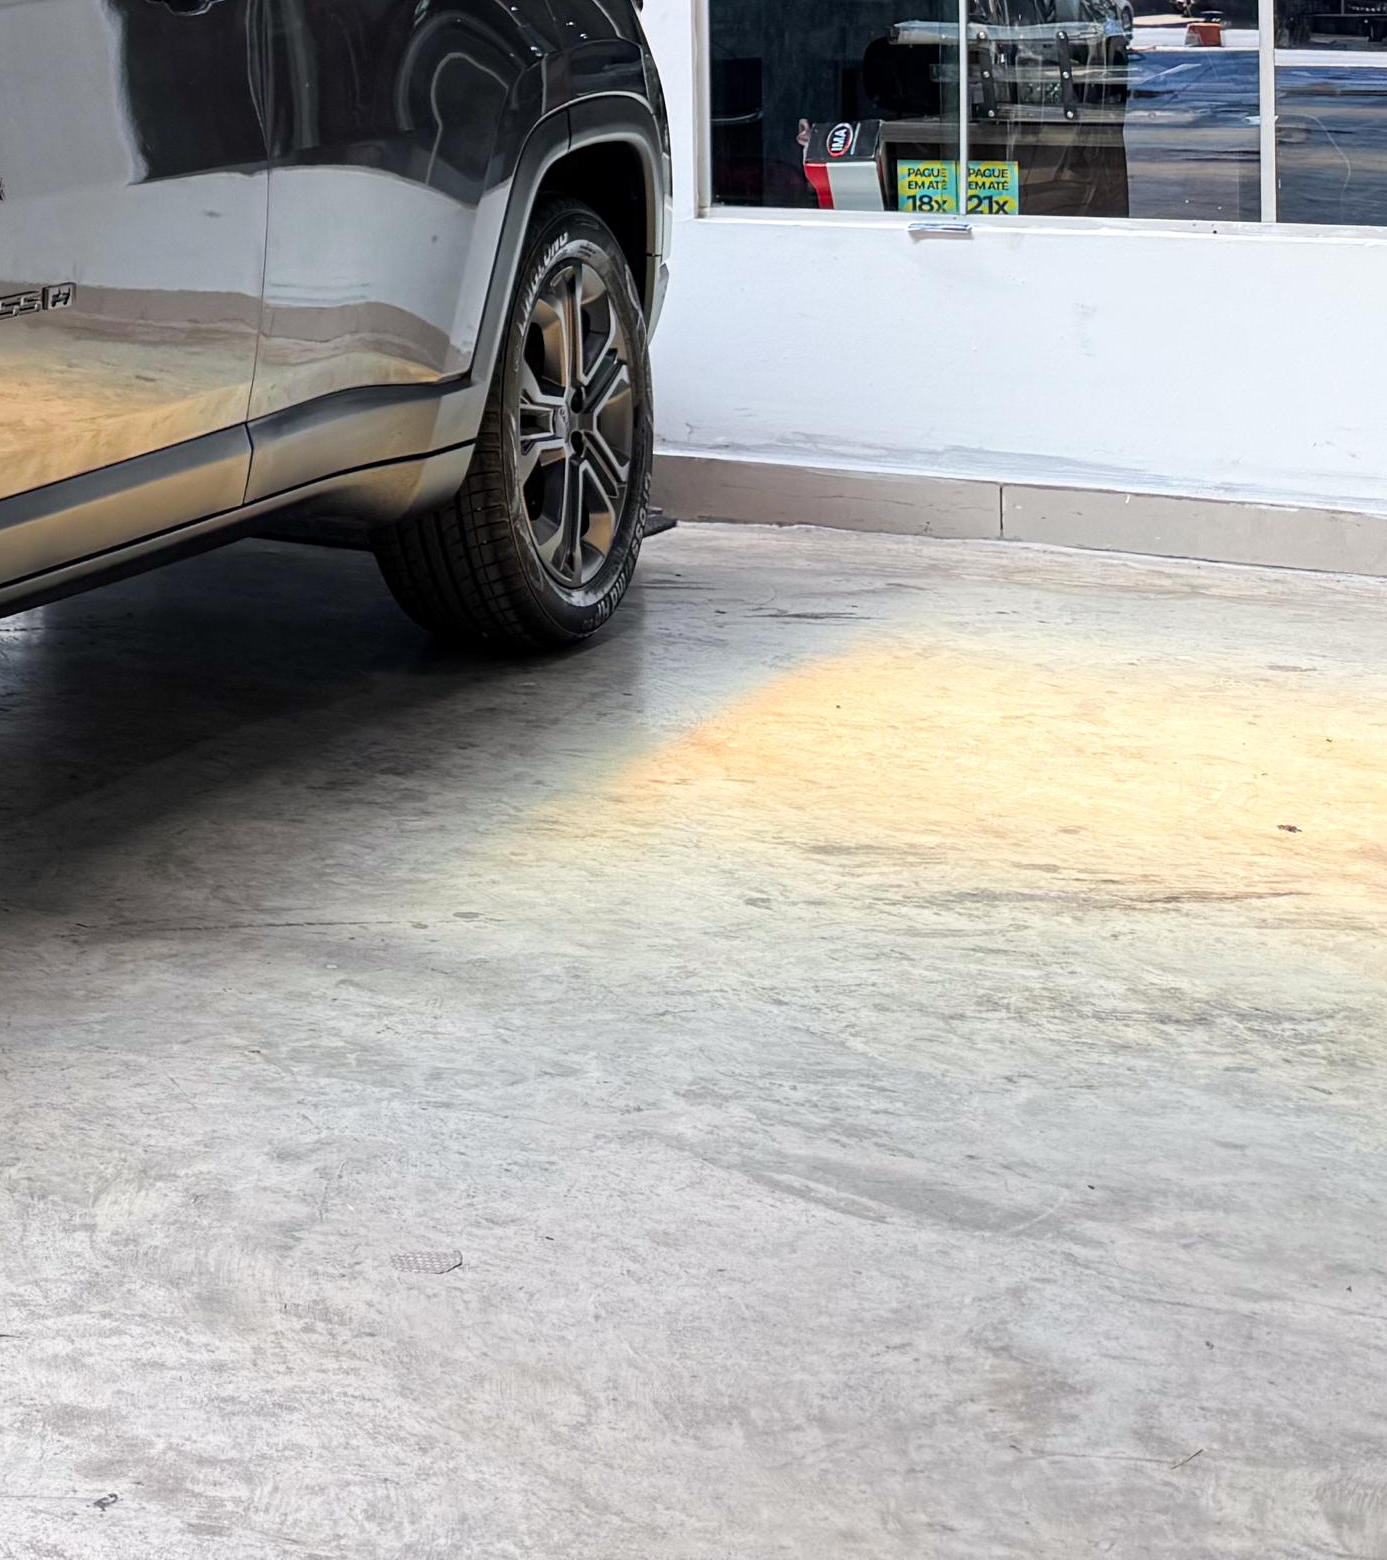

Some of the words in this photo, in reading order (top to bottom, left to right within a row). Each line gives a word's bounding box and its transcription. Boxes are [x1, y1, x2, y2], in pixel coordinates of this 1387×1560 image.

[907, 167, 948, 178] PAGUE
[967, 168, 1009, 178] PAGUE
[907, 180, 925, 190] EM
[927, 179, 948, 190] ATÉ
[968, 181, 986, 190] EM
[988, 179, 1009, 190] ATÉ
[906, 195, 948, 213] 18x
[967, 195, 1009, 215] 21x
